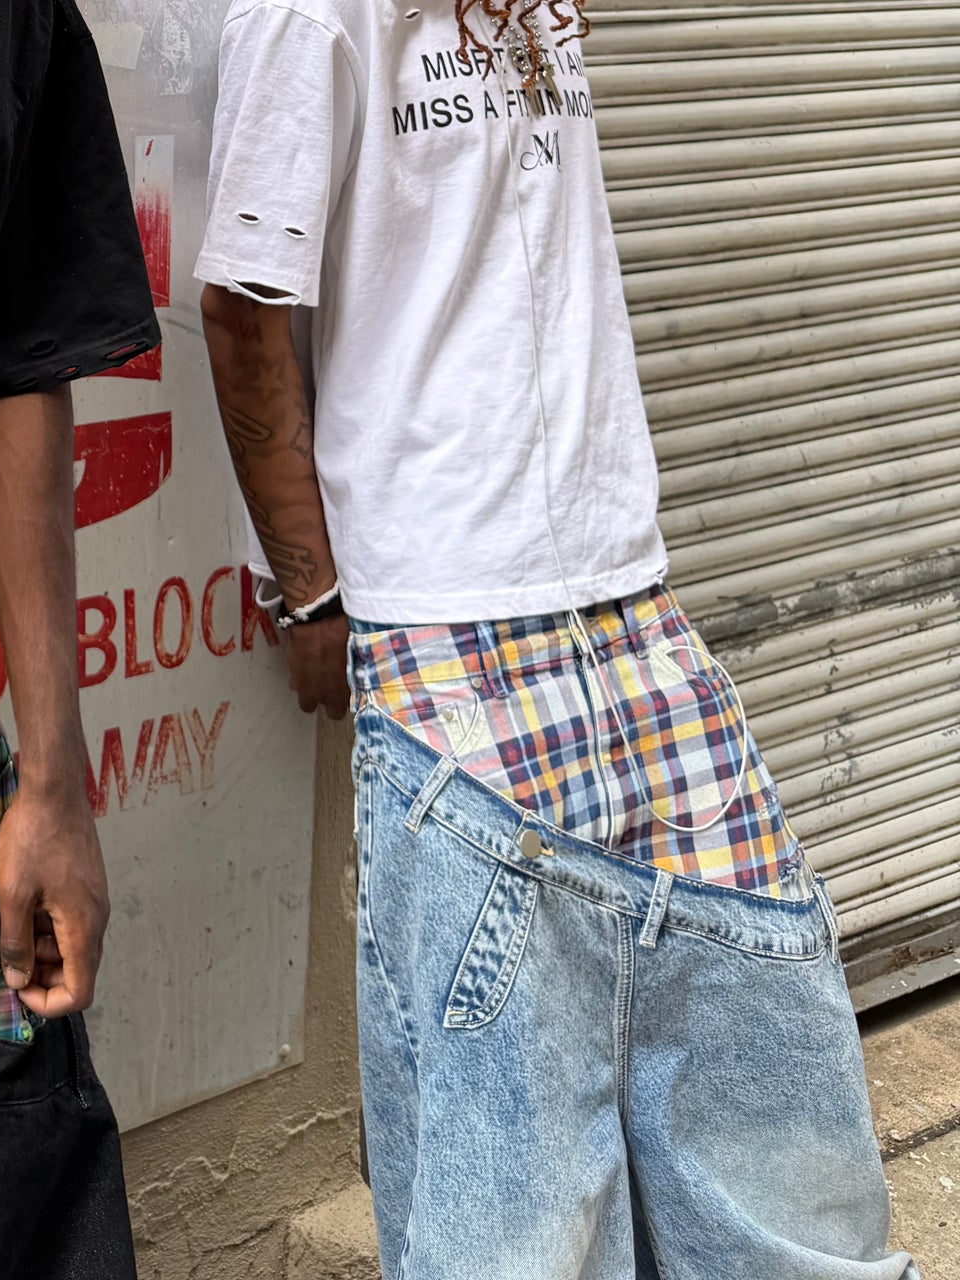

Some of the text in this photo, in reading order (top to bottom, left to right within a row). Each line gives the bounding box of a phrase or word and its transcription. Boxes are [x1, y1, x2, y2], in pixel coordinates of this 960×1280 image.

[392, 94, 474, 136] MISS
[484, 90, 499, 119] A
[76, 565, 280, 688] BLOCK
